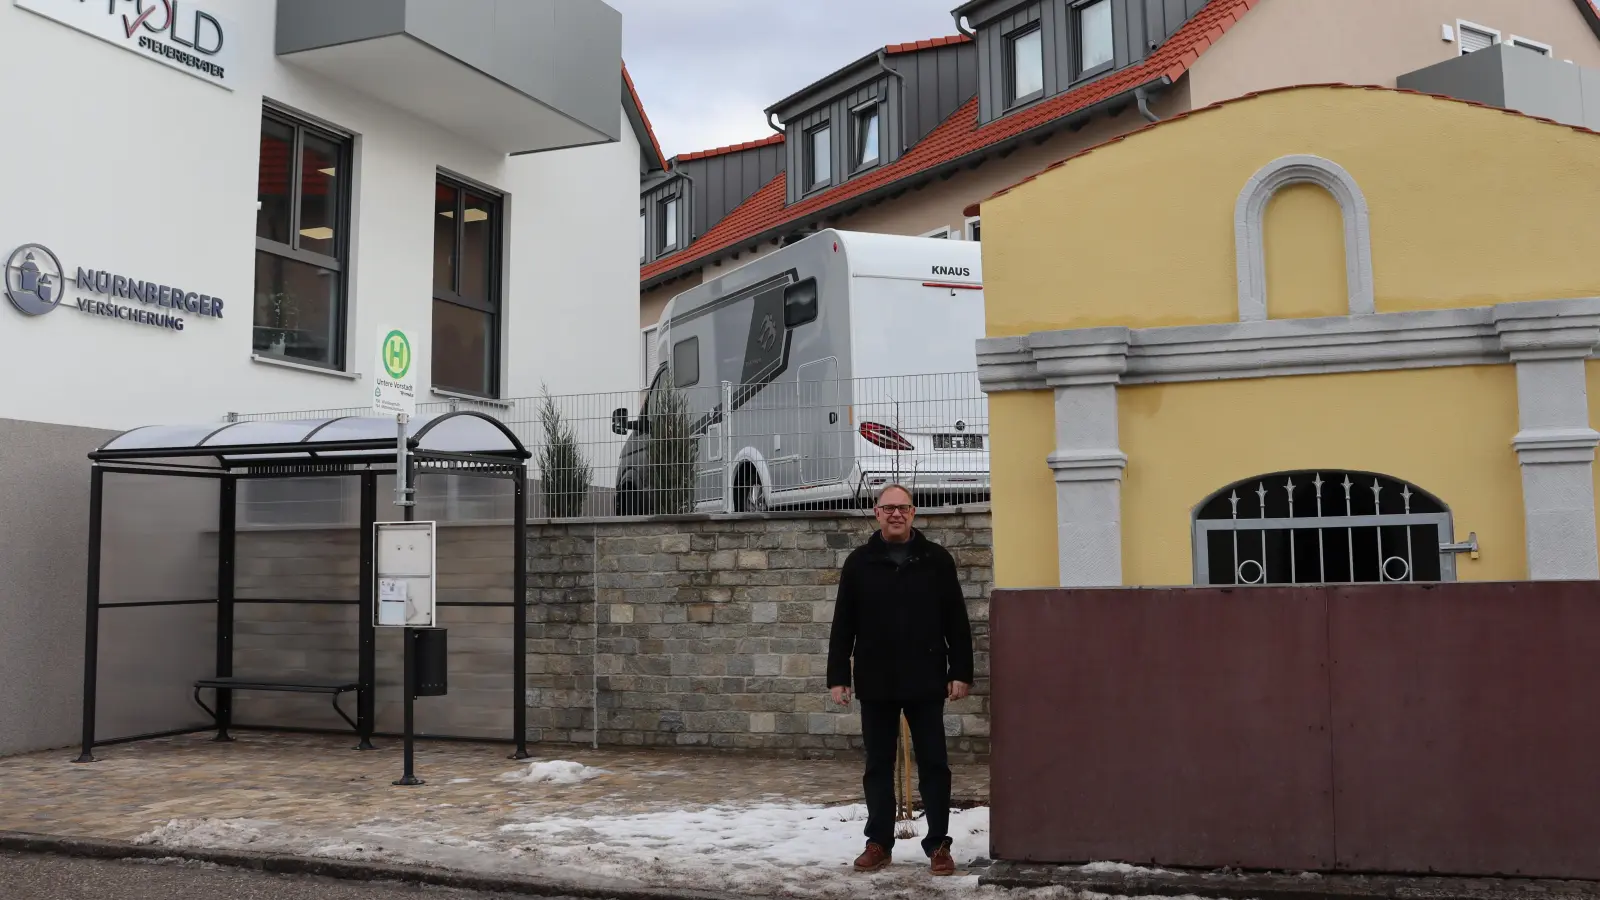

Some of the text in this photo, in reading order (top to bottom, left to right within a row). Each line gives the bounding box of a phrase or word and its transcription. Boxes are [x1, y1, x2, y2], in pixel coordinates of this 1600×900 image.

[138, 35, 225, 79] STEUERBERATER
[931, 265, 970, 277] KNAUS
[76, 266, 224, 319] NÜRNBERGER
[76, 297, 184, 331] VERSICHERUNG
[389, 339, 404, 369] H
[376, 378, 413, 392] Untere Vorstadt
